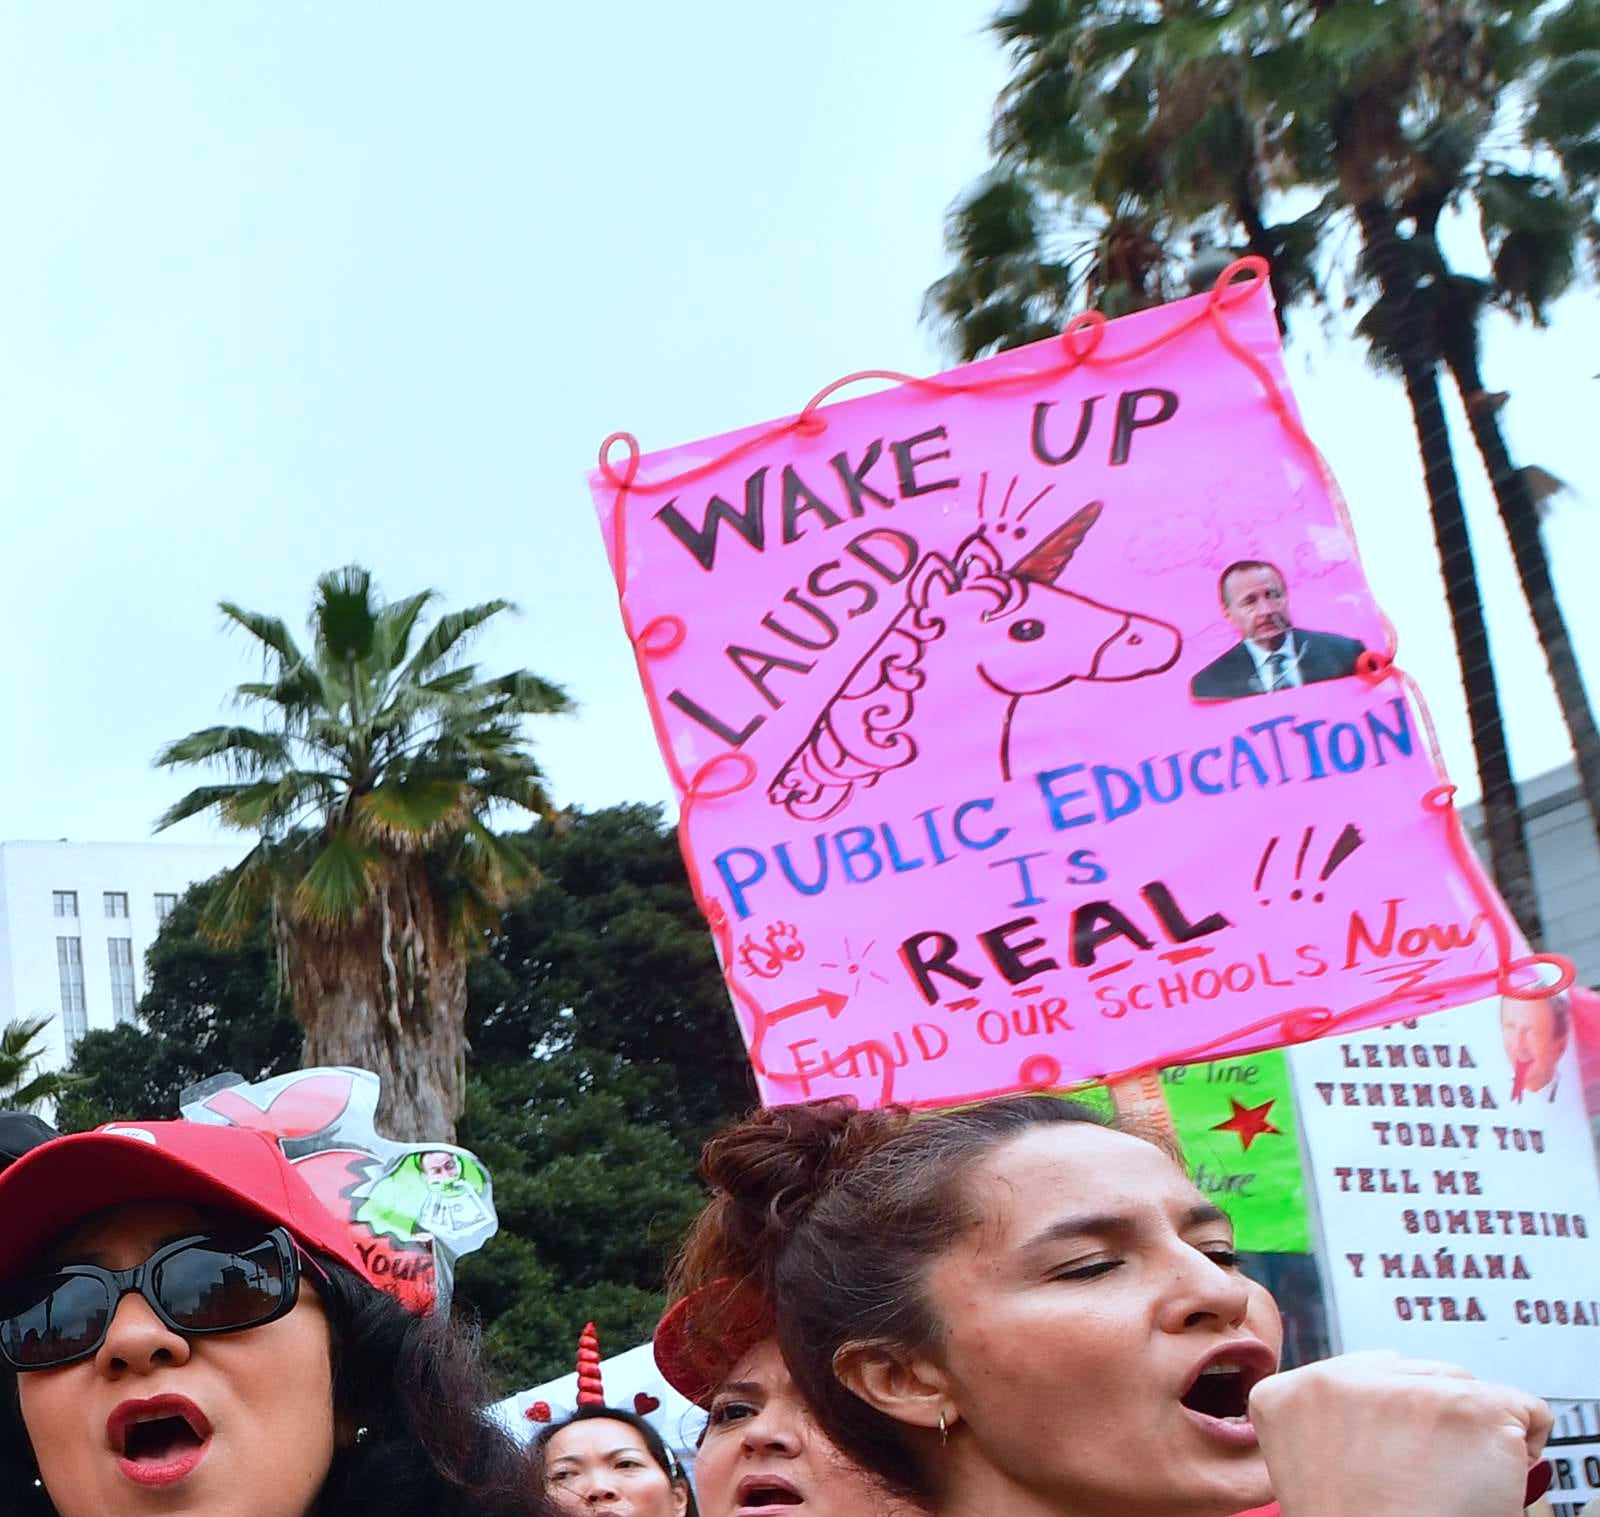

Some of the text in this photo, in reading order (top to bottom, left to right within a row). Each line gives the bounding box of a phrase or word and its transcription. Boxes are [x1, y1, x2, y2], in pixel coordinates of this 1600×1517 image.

[654, 388, 1180, 570] WAKE UP
[667, 528, 919, 747] LAUSD
[714, 699, 1414, 920] PUBLIC EDUCATION
[988, 848, 1108, 909] IS
[897, 880, 1232, 1008] REAL
[790, 899, 1485, 1090] FUND OUR SCHOOLS Now
[1341, 1044, 1477, 1068] LENGUA
[1315, 1082, 1498, 1109] VENENOSA
[1372, 1121, 1545, 1153] TODAY YOU
[1334, 1167, 1483, 1195] TELL ME
[1402, 1209, 1589, 1239] SOMETHING
[1346, 1247, 1532, 1280] Y MAÑANA
[1395, 1296, 1487, 1322] OTRA
